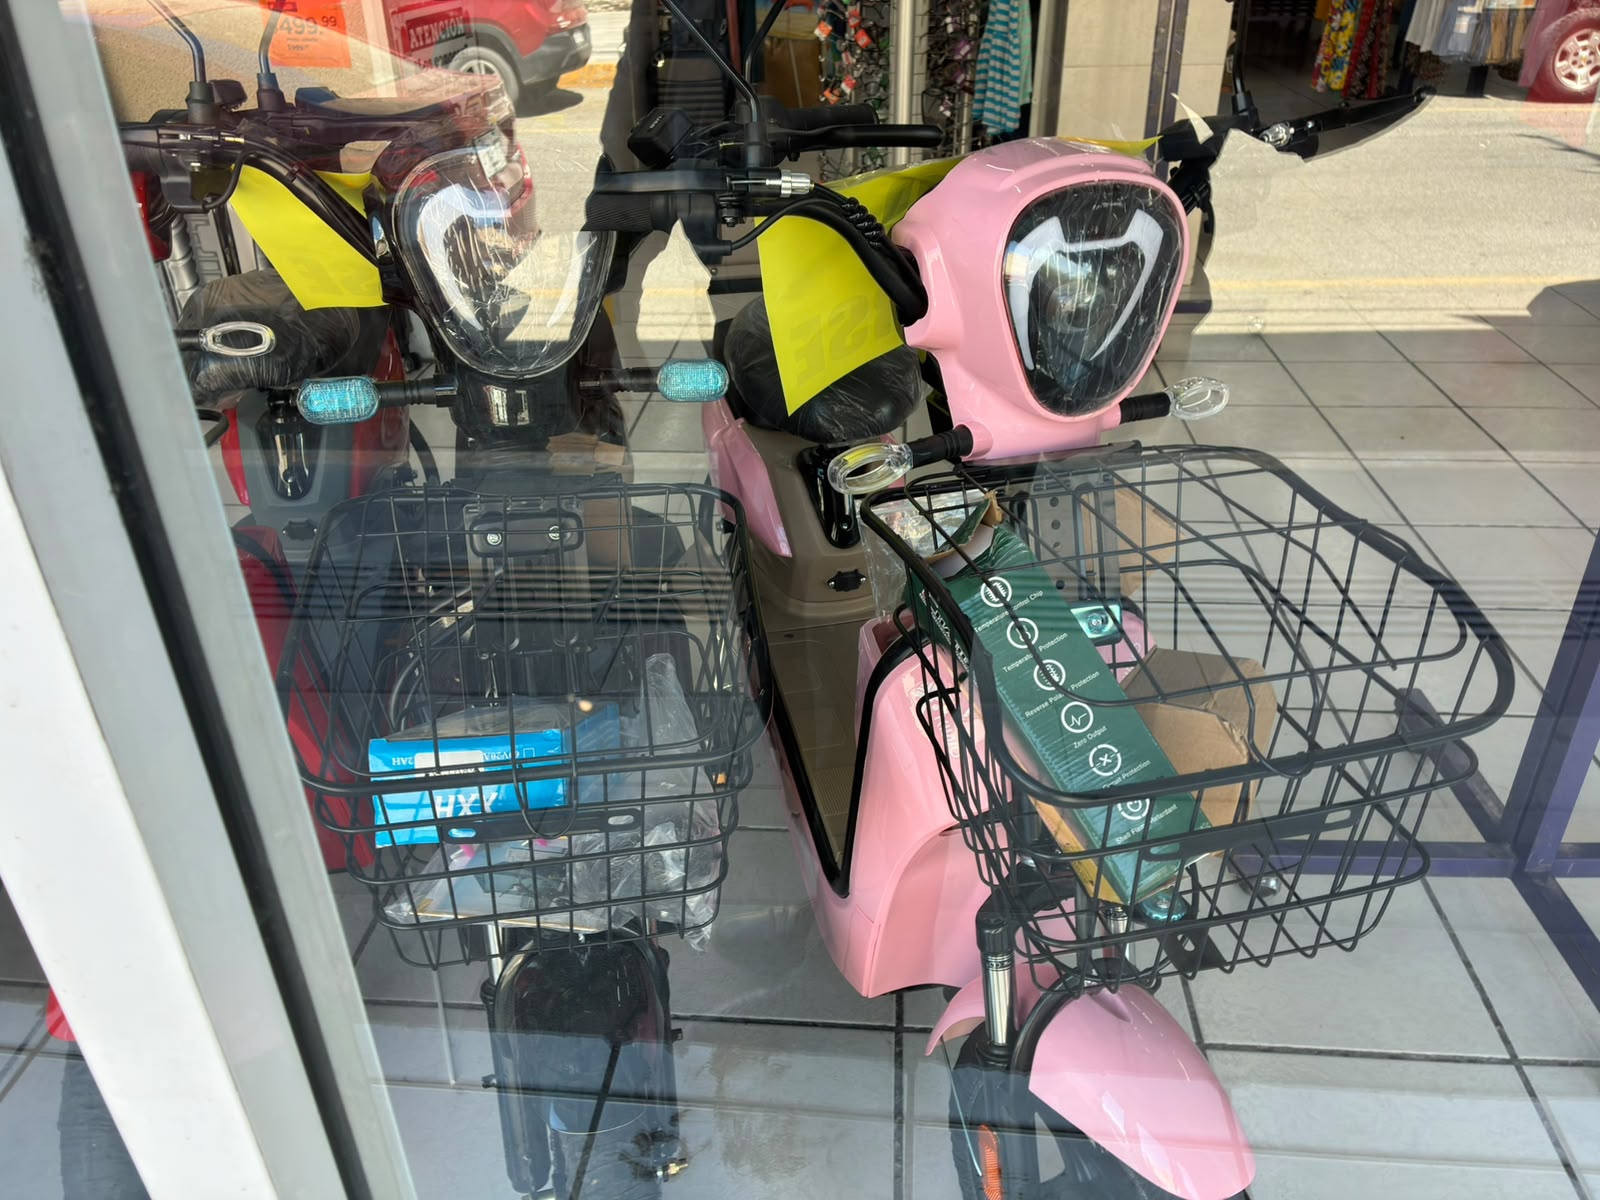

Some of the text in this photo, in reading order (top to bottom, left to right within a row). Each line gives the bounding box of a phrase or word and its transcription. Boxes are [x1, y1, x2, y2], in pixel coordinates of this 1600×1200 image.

[974, 610, 1010, 634] Temperature
[1029, 590, 1044, 603] Chip
[1003, 632, 1068, 673] Temperatu Protection
[1024, 698, 1050, 719] Reverse
[1070, 670, 1101, 694] Protection
[1073, 726, 1107, 749] Zero Output
[1122, 760, 1151, 781] Protection
